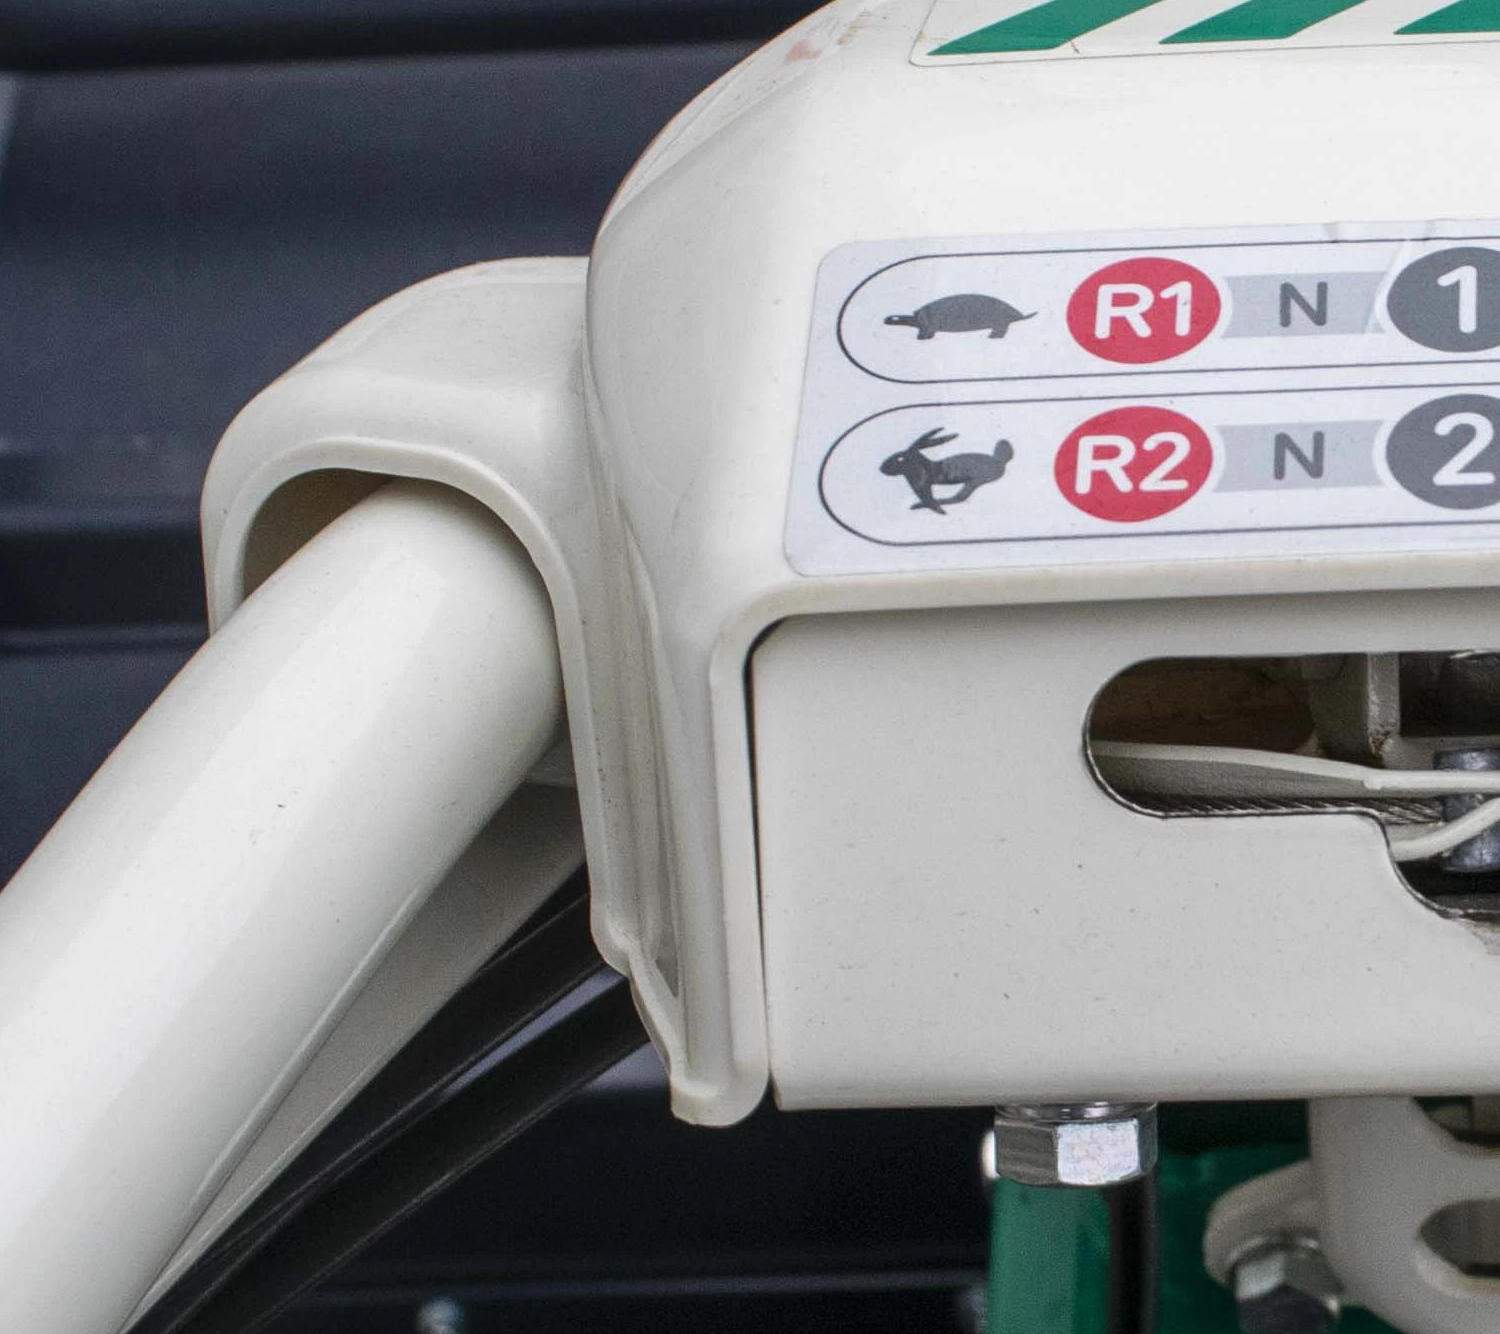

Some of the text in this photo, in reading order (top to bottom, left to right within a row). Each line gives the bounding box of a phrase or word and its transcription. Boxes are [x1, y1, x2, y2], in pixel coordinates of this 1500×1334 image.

[1095, 281, 1192, 339] R1
[1280, 282, 1328, 327] N
[1438, 266, 1477, 333] 1
[1076, 432, 1190, 494] R2
[1274, 431, 1324, 480] N
[1433, 413, 1495, 485] 2
